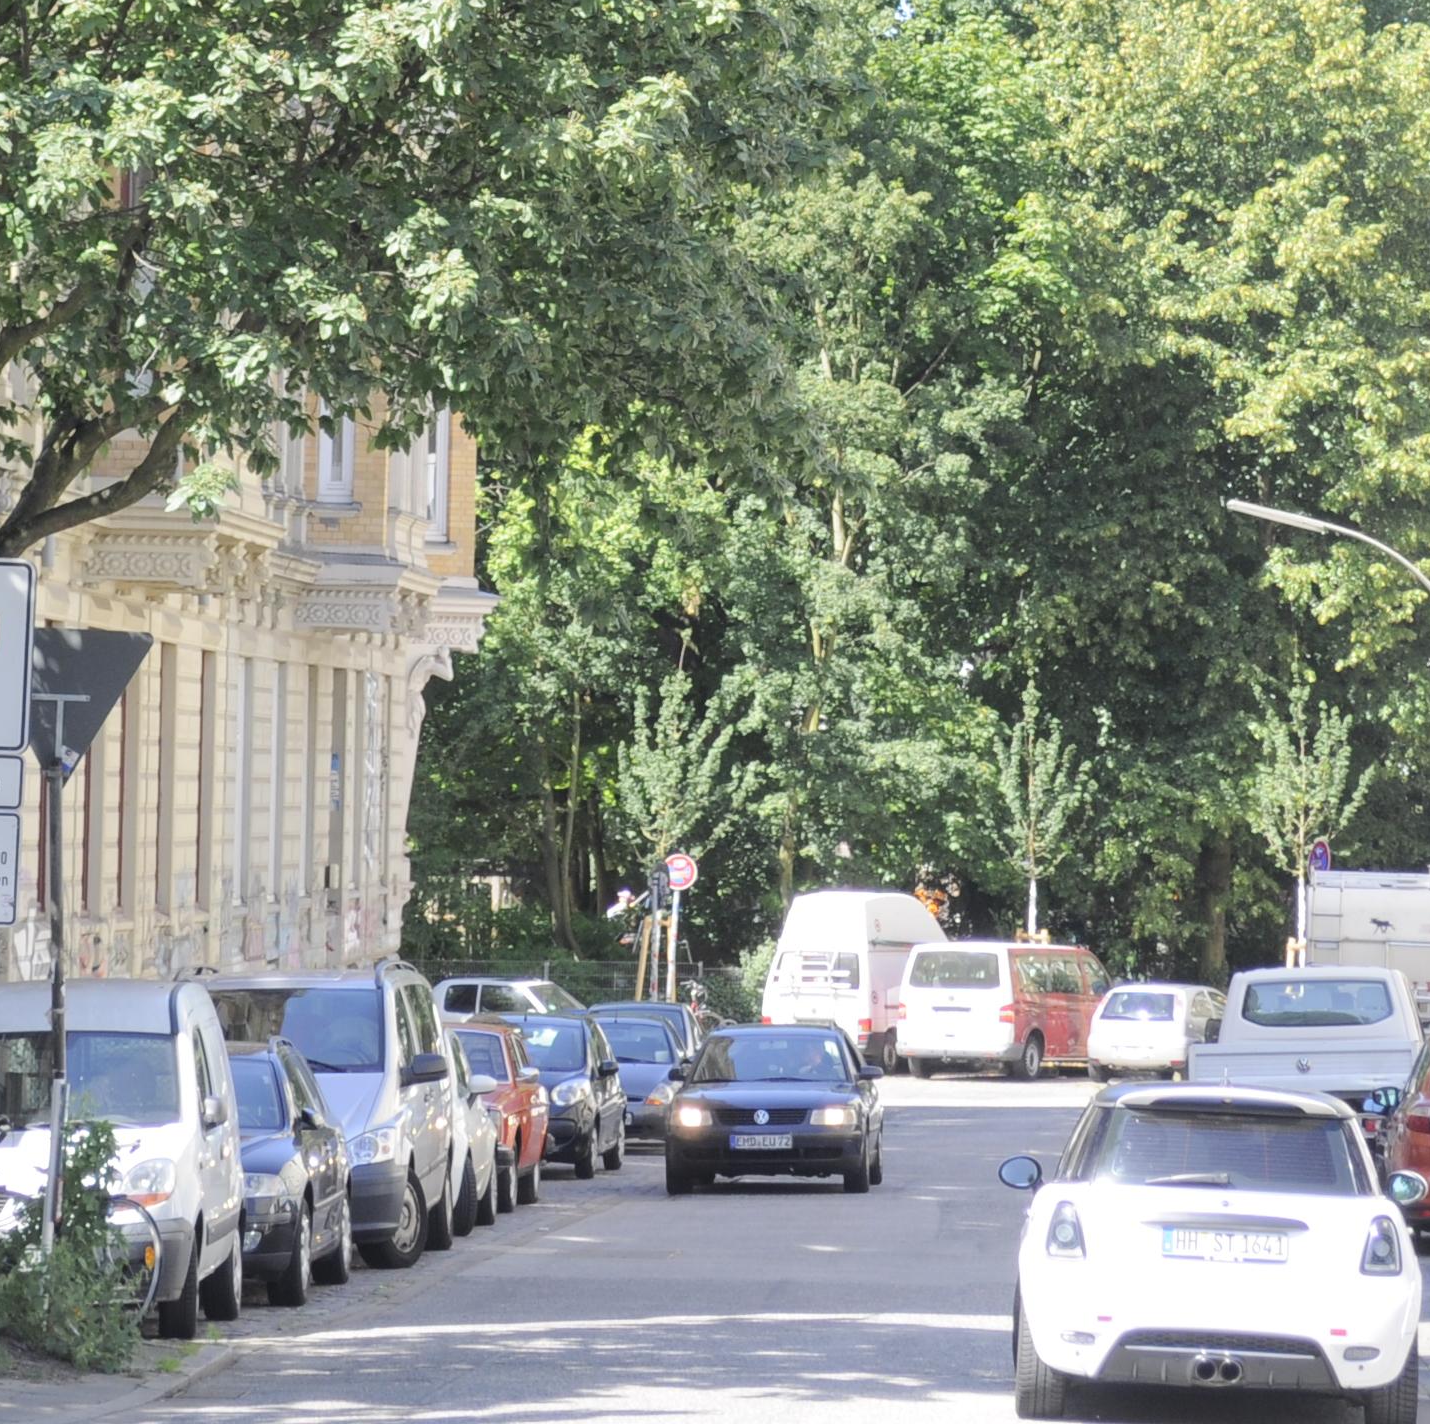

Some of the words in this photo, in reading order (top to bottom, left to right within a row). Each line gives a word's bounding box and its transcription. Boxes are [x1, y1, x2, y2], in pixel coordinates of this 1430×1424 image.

[1176, 1231, 1198, 1251] HH
[1213, 1232, 1235, 1252] ST
[1242, 1234, 1284, 1256] 1641
